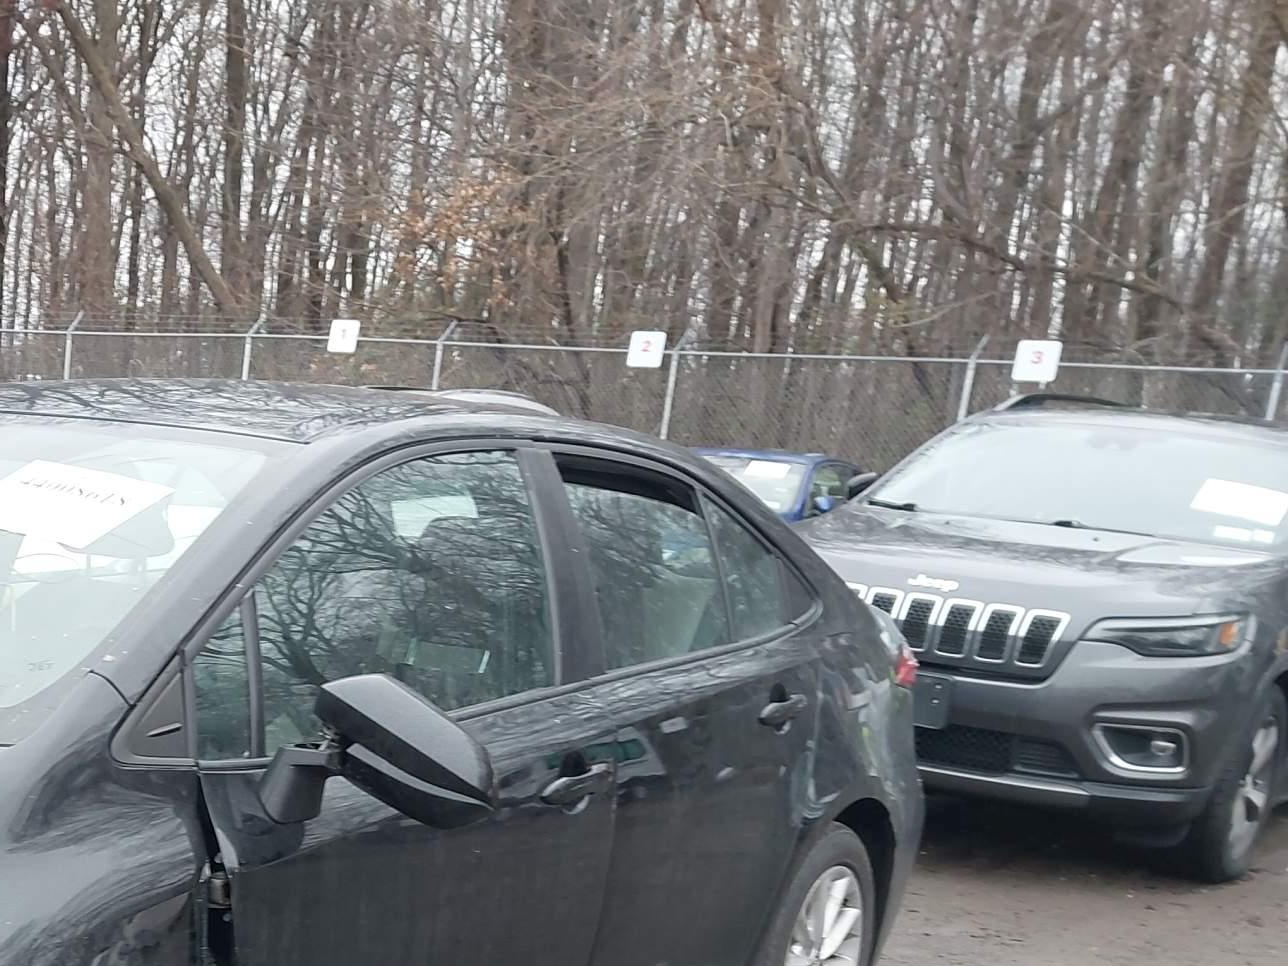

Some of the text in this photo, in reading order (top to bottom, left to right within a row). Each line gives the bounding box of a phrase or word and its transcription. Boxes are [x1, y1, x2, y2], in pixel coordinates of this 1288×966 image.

[640, 340, 652, 352] 2
[1030, 350, 1044, 364] 3
[907, 573, 960, 592] Jeep
